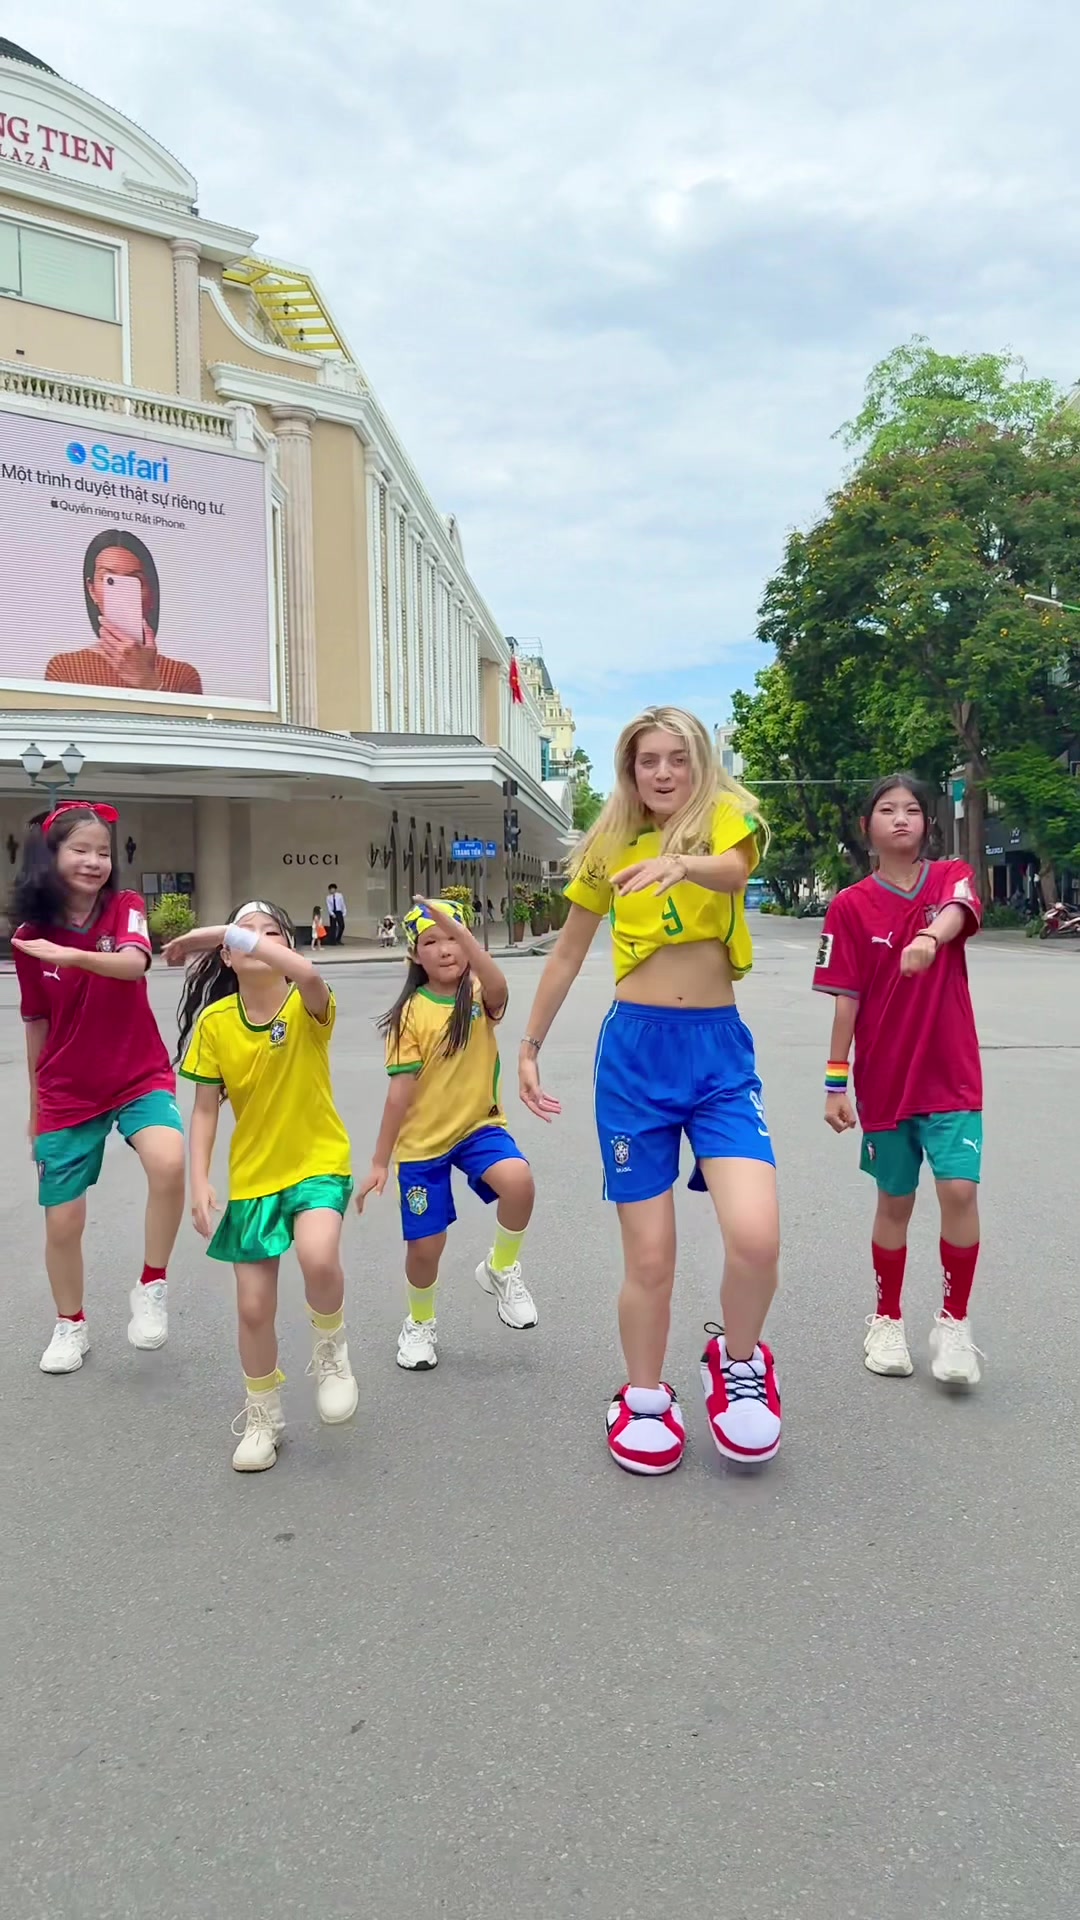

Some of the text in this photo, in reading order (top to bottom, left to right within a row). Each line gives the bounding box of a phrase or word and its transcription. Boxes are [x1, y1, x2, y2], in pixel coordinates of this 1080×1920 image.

[37, 124, 115, 171] TIEN
[91, 444, 169, 483] Safari
[2, 463, 33, 484] Một
[36, 470, 71, 488] trình
[74, 477, 117, 499] duyệt
[120, 484, 149, 505] thật
[151, 493, 170, 509] sự
[172, 494, 206, 515] riêng
[282, 853, 339, 865] GUCCI
